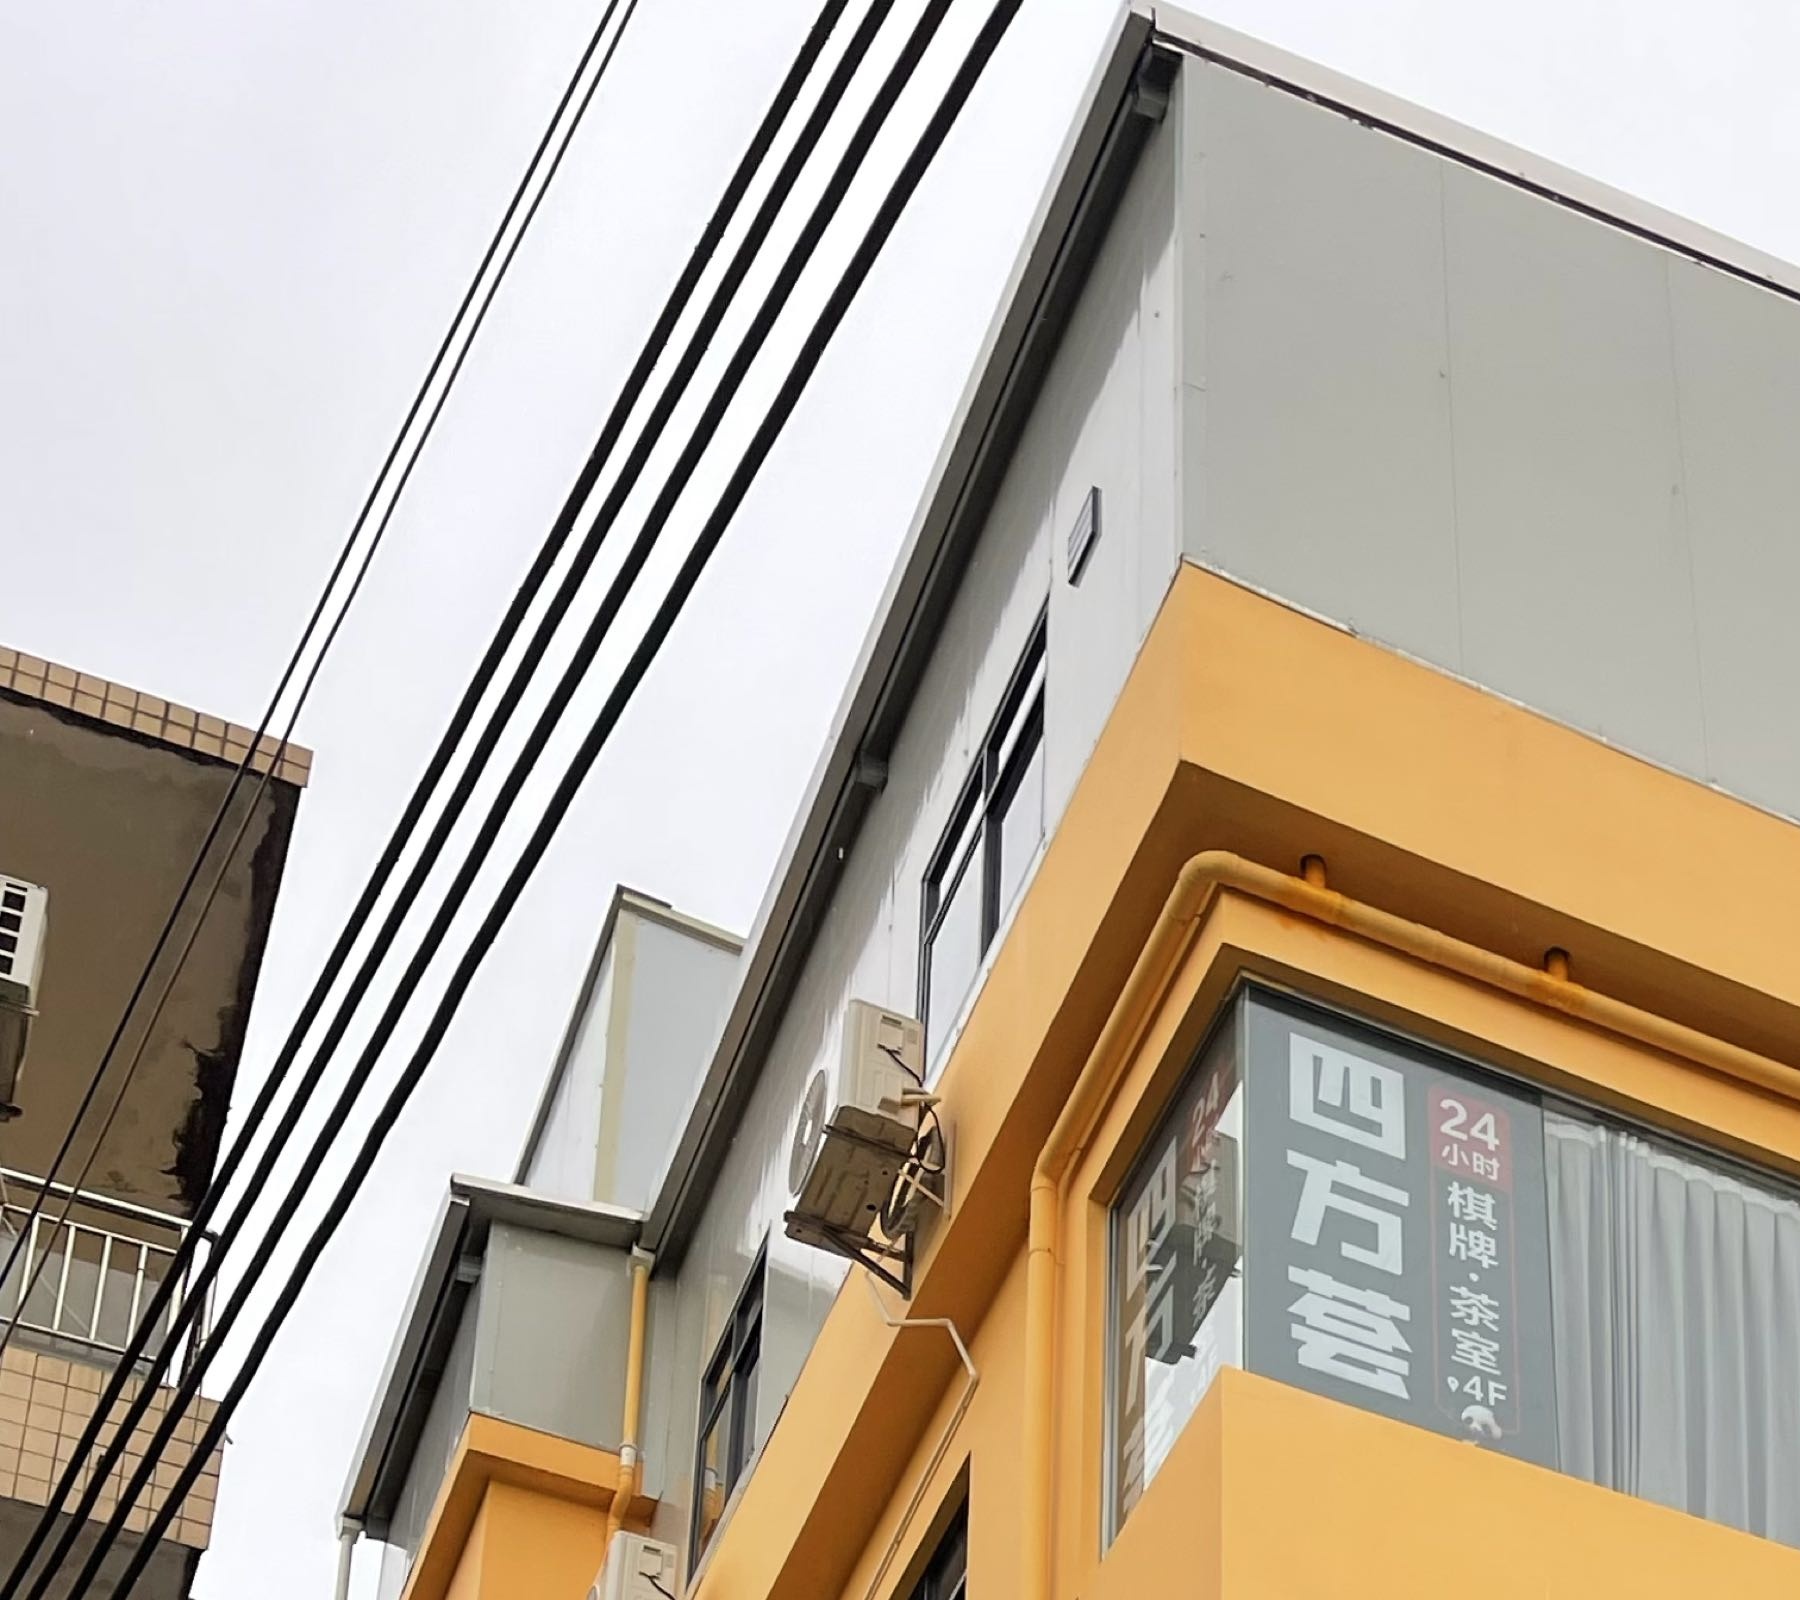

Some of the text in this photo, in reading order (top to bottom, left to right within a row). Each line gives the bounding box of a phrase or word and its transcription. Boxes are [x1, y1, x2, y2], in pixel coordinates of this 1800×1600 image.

[1439, 1098, 1500, 1151] 24
[1441, 1142, 1501, 1181] 小时
[1287, 1032, 1413, 1400] 四方荟
[1464, 1375, 1508, 1406] 4F
